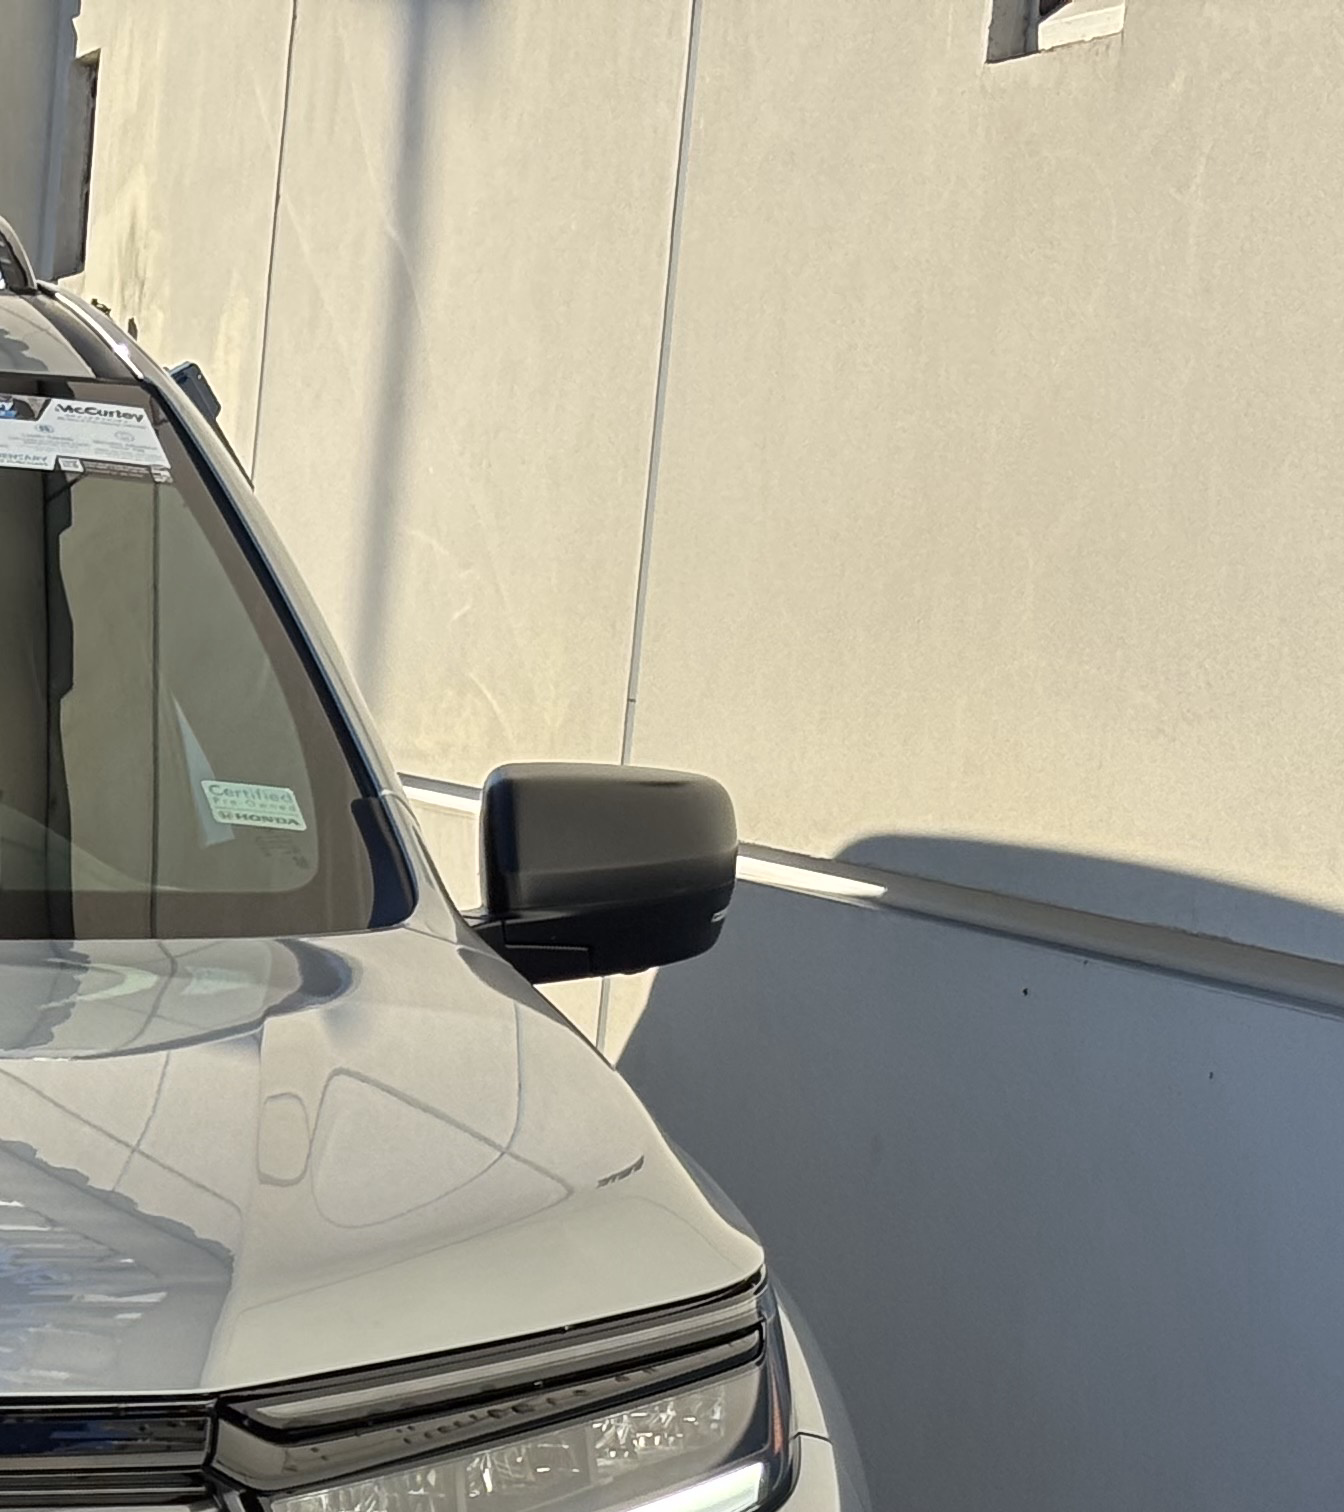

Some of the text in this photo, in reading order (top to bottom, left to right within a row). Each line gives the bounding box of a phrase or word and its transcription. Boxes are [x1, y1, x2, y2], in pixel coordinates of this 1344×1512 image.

[55, 403, 144, 423] McCurley
[208, 784, 294, 804] Certified
[235, 812, 301, 826] HONDA
